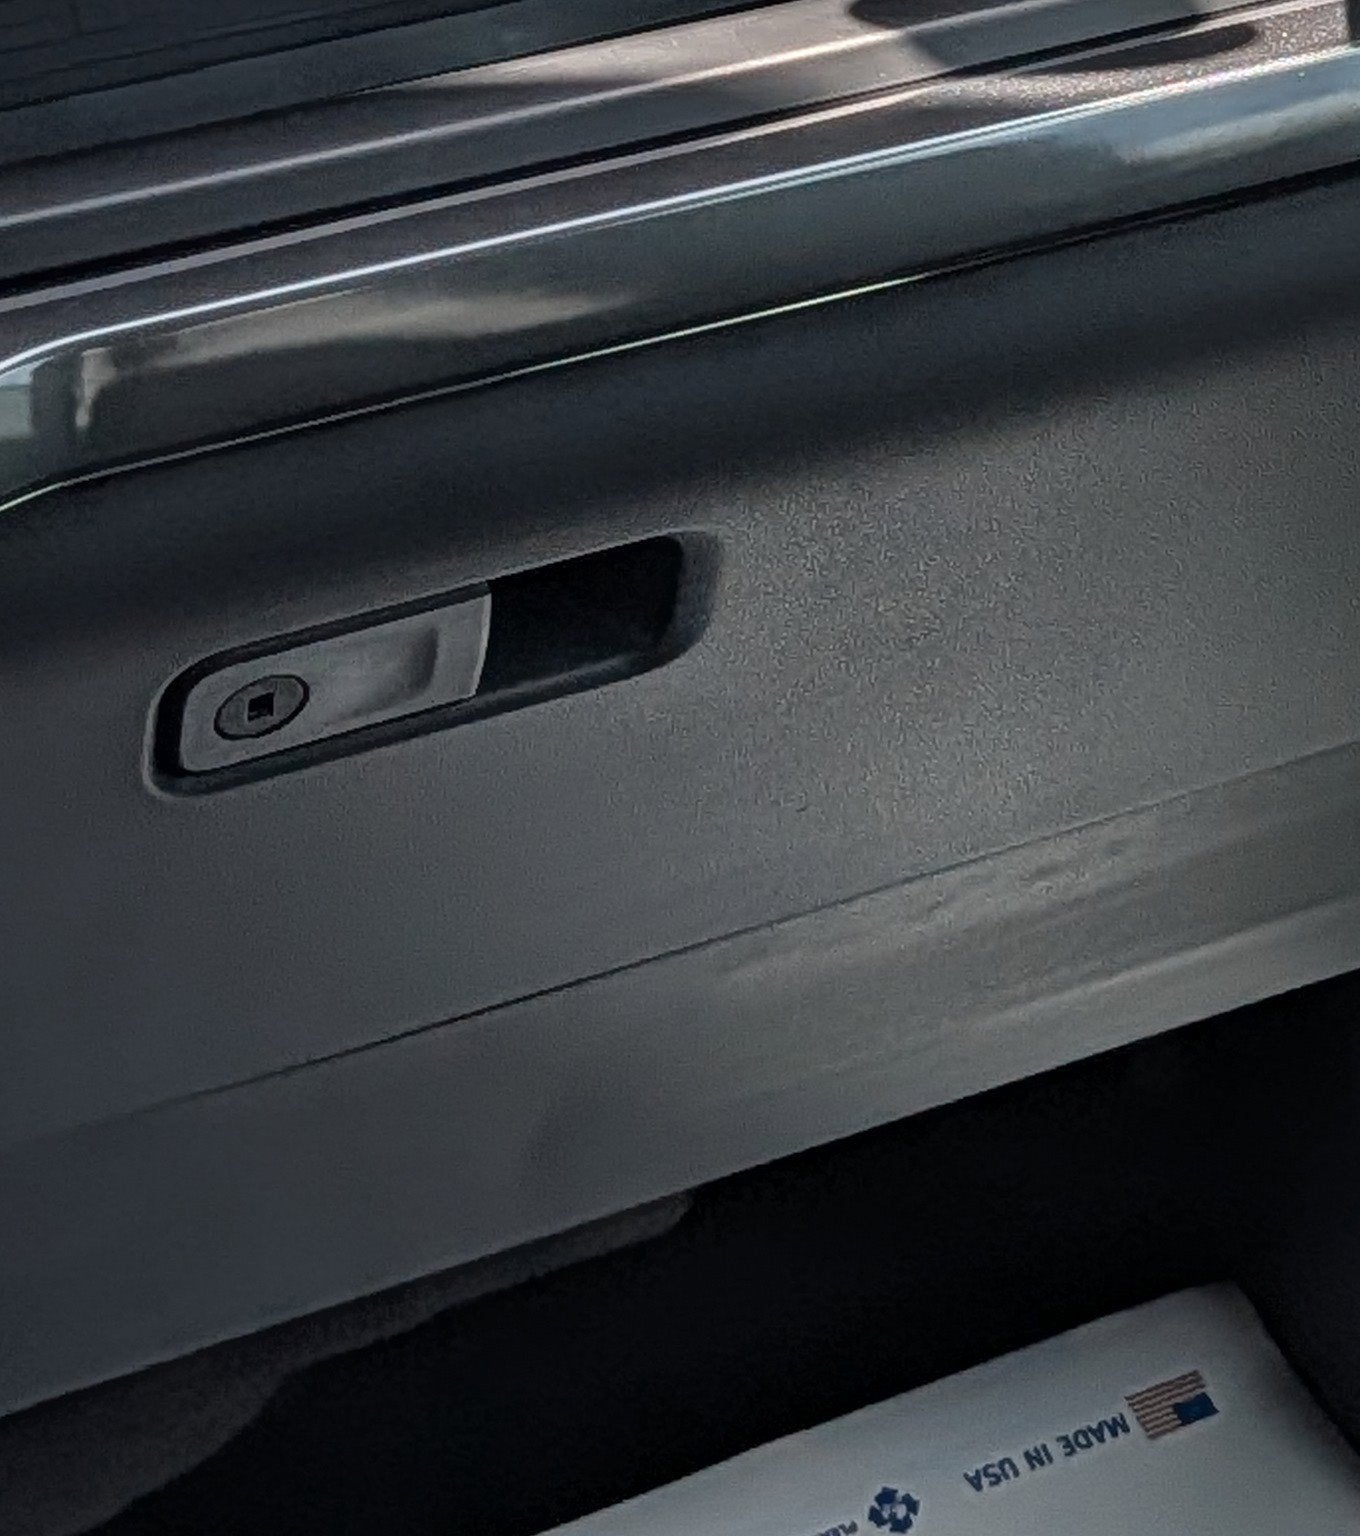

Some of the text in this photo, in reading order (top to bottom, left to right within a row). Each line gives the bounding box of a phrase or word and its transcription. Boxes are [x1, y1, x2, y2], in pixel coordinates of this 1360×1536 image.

[962, 1412, 1131, 1492] MADE IN USA
